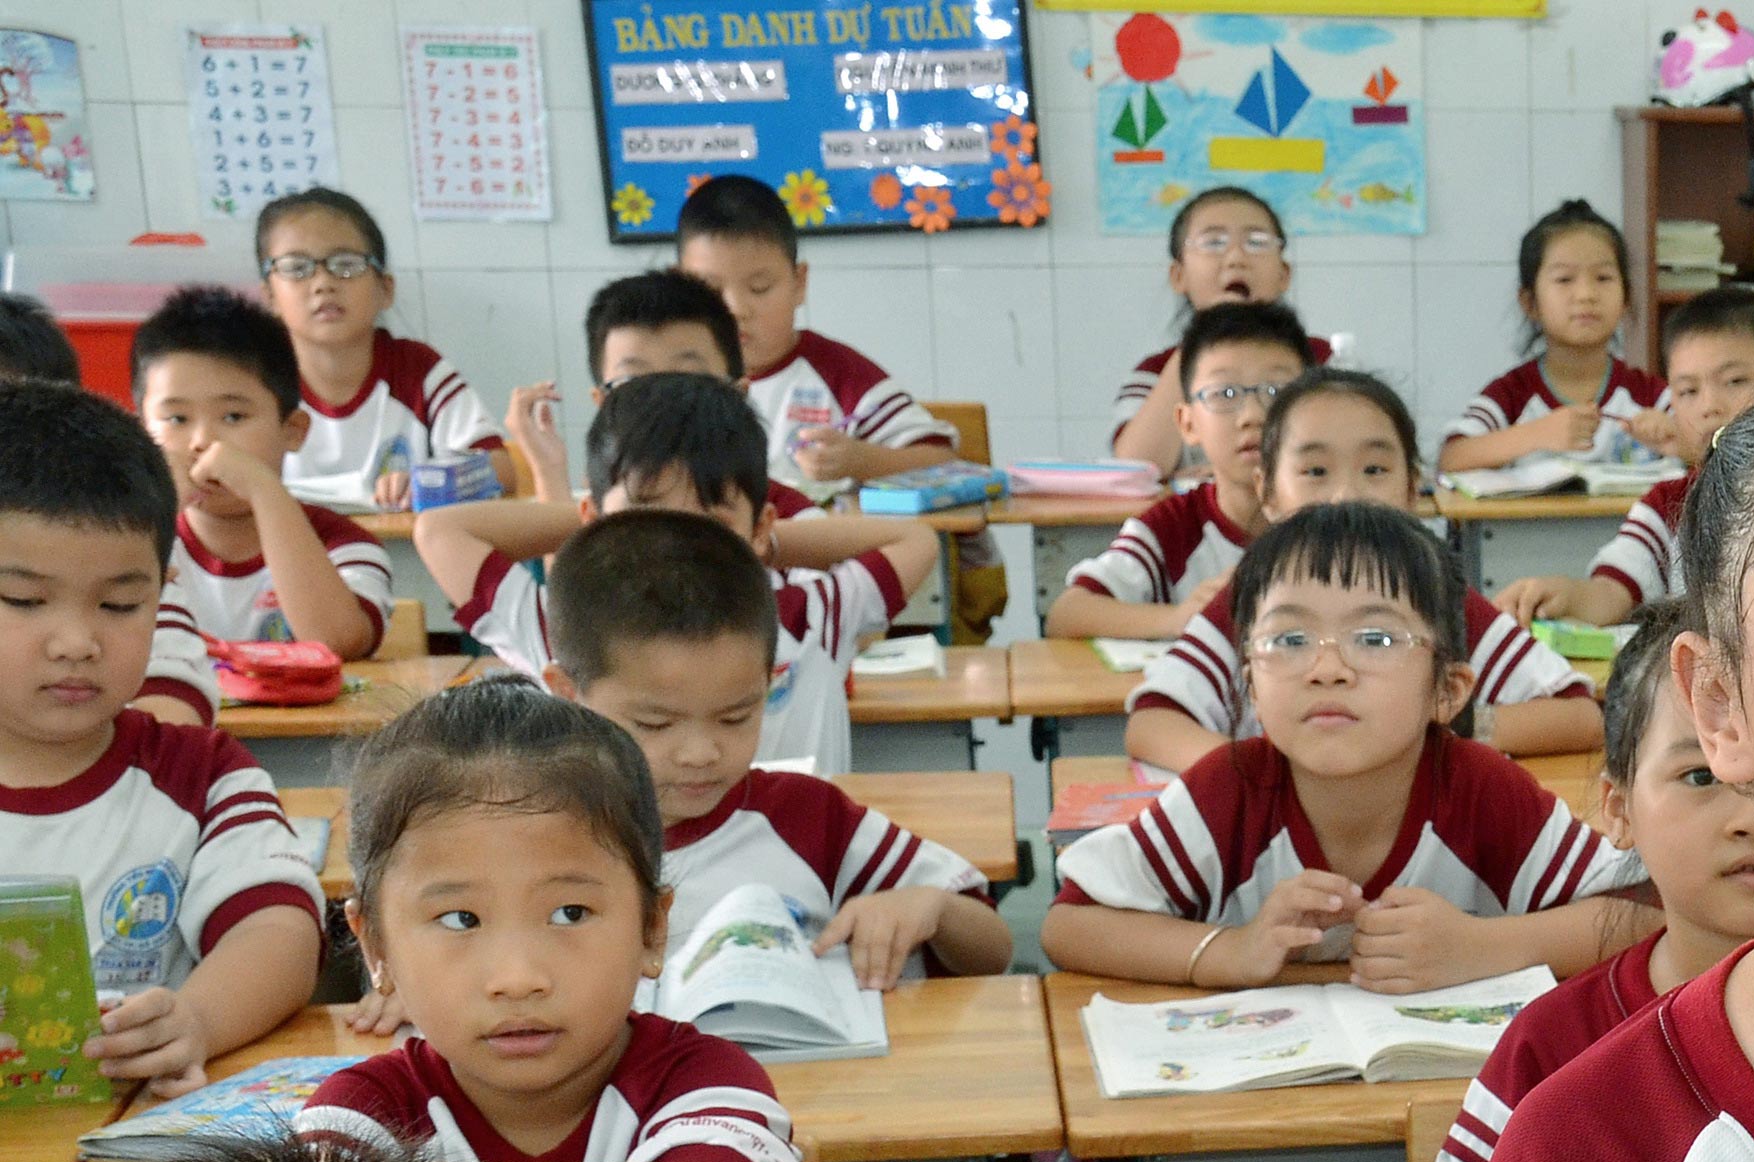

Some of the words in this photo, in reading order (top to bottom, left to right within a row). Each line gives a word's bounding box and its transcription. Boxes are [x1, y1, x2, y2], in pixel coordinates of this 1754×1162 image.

[615, 3, 709, 52] BẢNG
[721, 11, 817, 48] DANH
[826, 6, 871, 49] DỰ
[203, 56, 216, 72] 6
[226, 60, 237, 70] +
[251, 56, 258, 72] 1
[271, 61, 285, 70] =
[296, 56, 306, 73] 7
[426, 60, 437, 78] 7
[464, 62, 472, 79] 1
[483, 66, 495, 76] =
[504, 63, 518, 80] 6
[206, 80, 218, 97] 5
[231, 86, 239, 94] +
[252, 81, 264, 98] 2
[275, 86, 288, 95] =
[298, 81, 309, 98] 7
[428, 84, 439, 101] 7
[465, 85, 476, 102] 2
[485, 90, 497, 98] =
[508, 86, 520, 103] 5
[209, 106, 222, 122] 4
[233, 110, 243, 120] +
[255, 105, 267, 123] 3
[277, 111, 291, 120] =
[301, 106, 312, 123] 7
[430, 108, 441, 124] 7
[467, 109, 478, 125] 3
[486, 113, 499, 122] =
[509, 111, 520, 124] 4
[215, 130, 222, 146] 1
[237, 135, 246, 144] +
[258, 132, 271, 148] 6
[280, 136, 294, 145] =
[303, 130, 314, 147] 7
[432, 131, 443, 147] 7
[468, 134, 479, 147] 4
[488, 136, 501, 145] =
[511, 133, 522, 150] 3
[214, 155, 227, 172] 2
[240, 159, 249, 169] +
[260, 155, 272, 172] 5
[283, 160, 296, 169] =
[306, 156, 317, 172] 7
[434, 155, 445, 171] 7
[470, 156, 482, 172] 5
[490, 159, 503, 168] =
[512, 156, 524, 172] 2
[219, 179, 231, 196] 3
[242, 185, 252, 194] +
[264, 181, 276, 195] 4
[285, 186, 298, 194] =
[435, 178, 447, 194] 7
[471, 178, 484, 195] 6
[492, 182, 504, 191] =
[516, 180, 524, 193] 1
